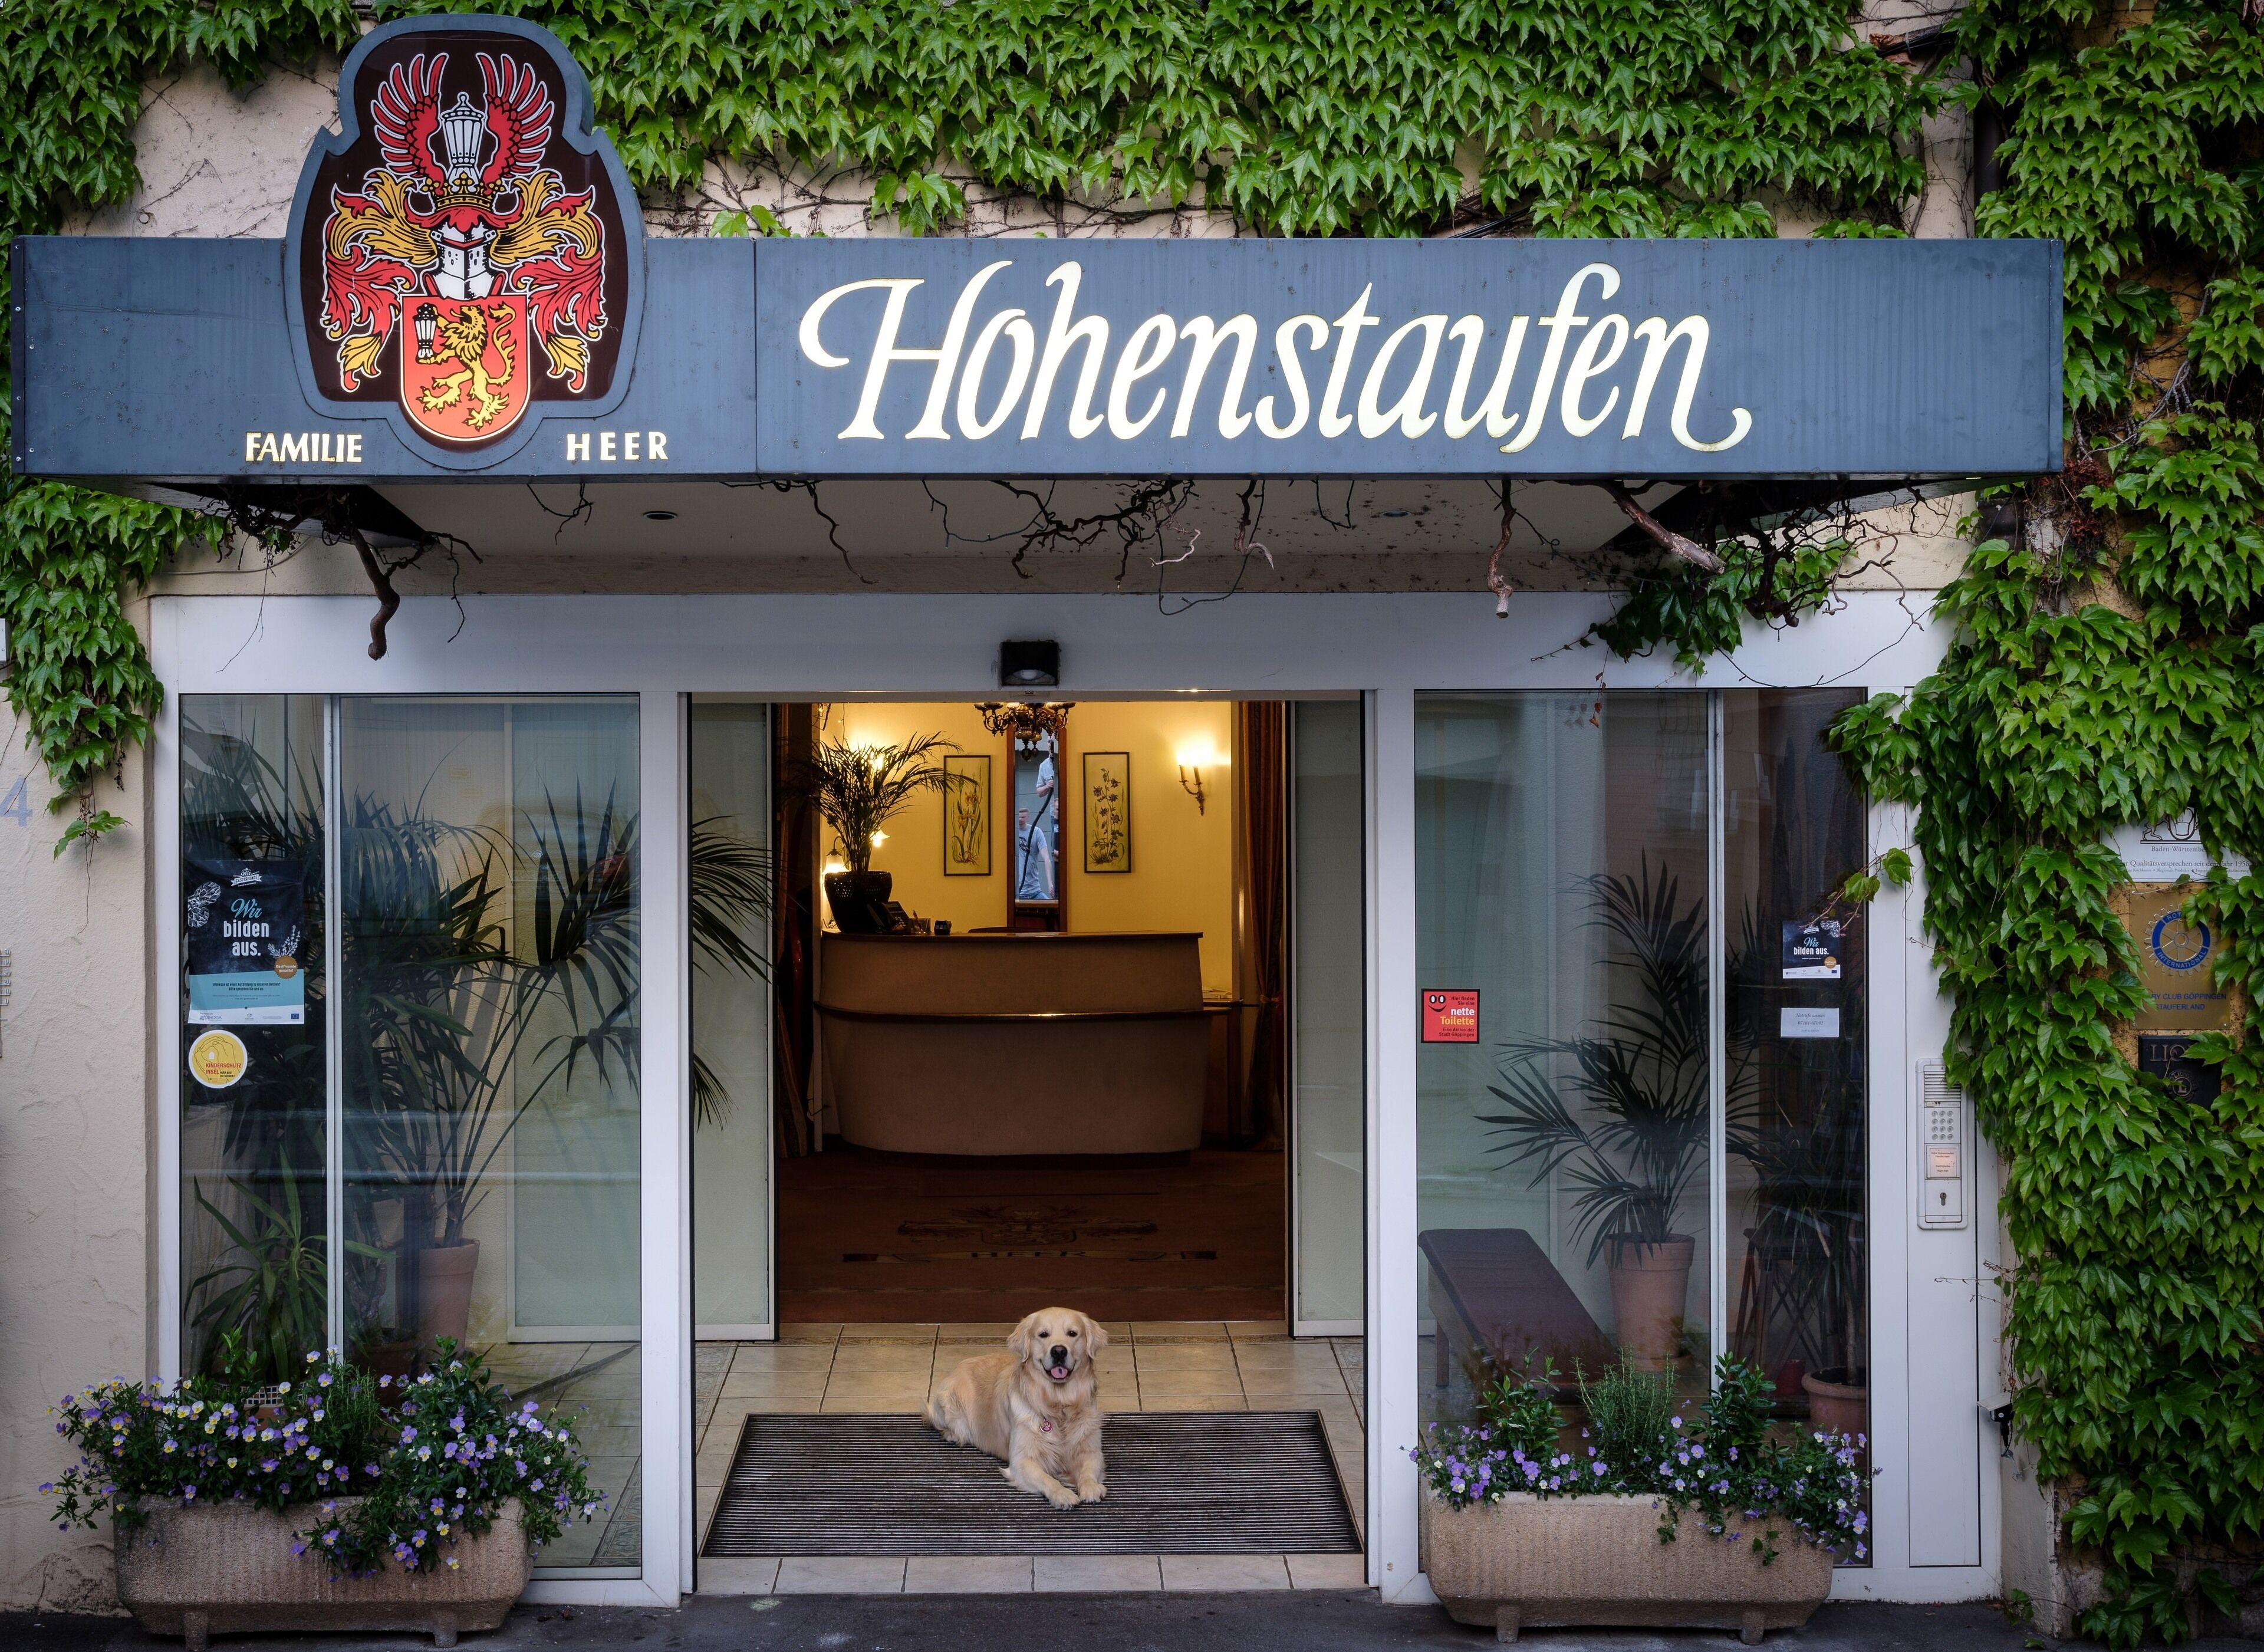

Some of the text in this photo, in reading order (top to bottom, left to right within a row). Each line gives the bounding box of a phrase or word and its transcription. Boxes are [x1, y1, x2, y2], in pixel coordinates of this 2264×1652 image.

[798, 259, 1753, 453] Hohenstaufen
[245, 431, 362, 463] FAMILIE
[566, 431, 669, 461] HEER
[231, 898, 262, 918] Wir
[223, 919, 269, 937] bilden
[232, 942, 261, 956] aus.
[1804, 937, 1819, 947] Wir
[1794, 946, 1814, 955] bilden
[2157, 950, 2206, 969] INTERNATIONAL
[2183, 992, 2227, 1000] GÖPPINGEN
[1451, 1008, 1475, 1016] nette
[1440, 1016, 1475, 1025] Toilette
